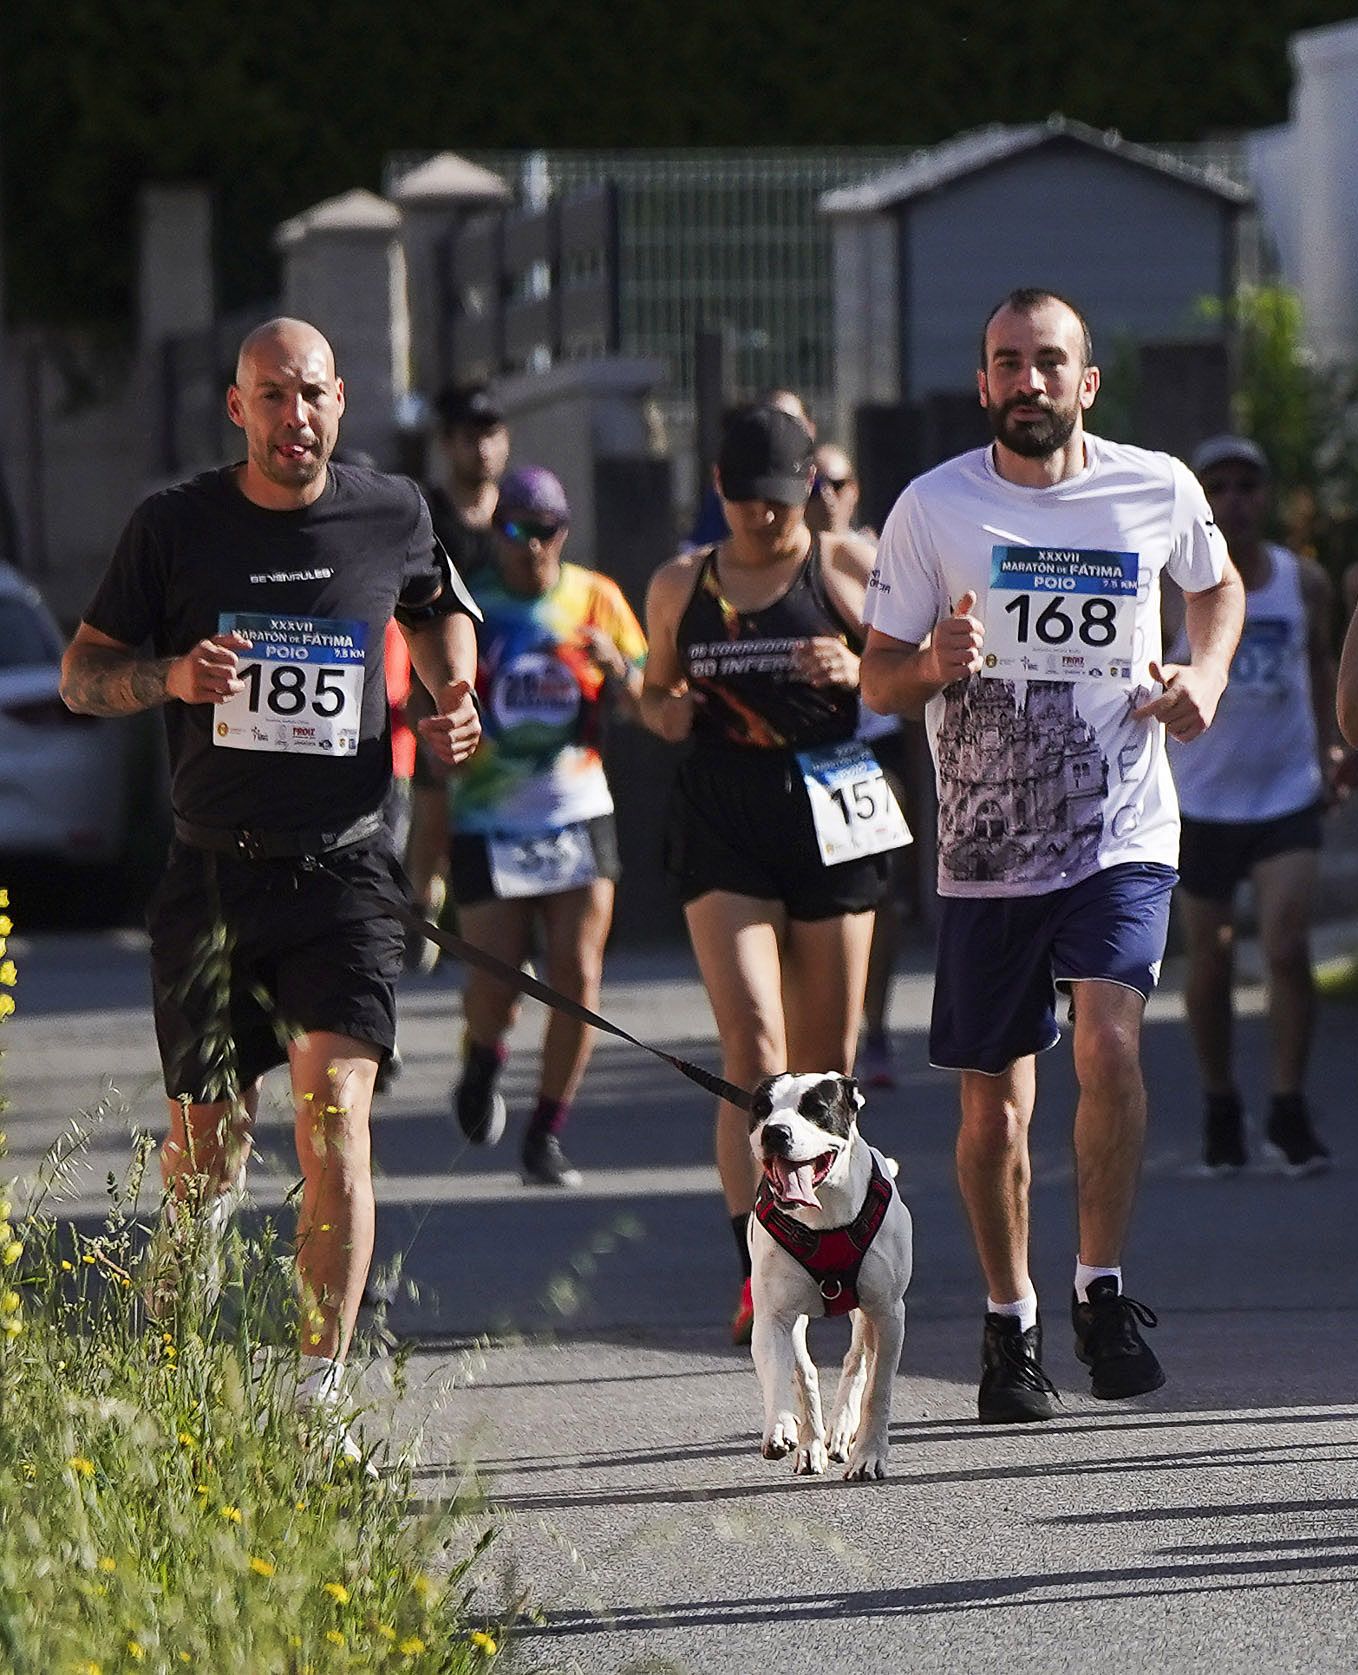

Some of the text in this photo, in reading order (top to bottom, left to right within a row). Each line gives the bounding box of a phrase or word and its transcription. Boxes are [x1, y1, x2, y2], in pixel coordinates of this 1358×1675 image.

[1038, 551, 1080, 562] XXXVII
[1002, 561, 1056, 573] MARATÓN
[1069, 564, 1123, 578] FÁTIMA
[1034, 576, 1076, 590] POIO
[270, 620, 313, 632] XXXVII
[1005, 594, 1117, 647] 168
[302, 634, 353, 648] FÁTIMA
[266, 645, 309, 660] POIO
[237, 663, 345, 717] 185
